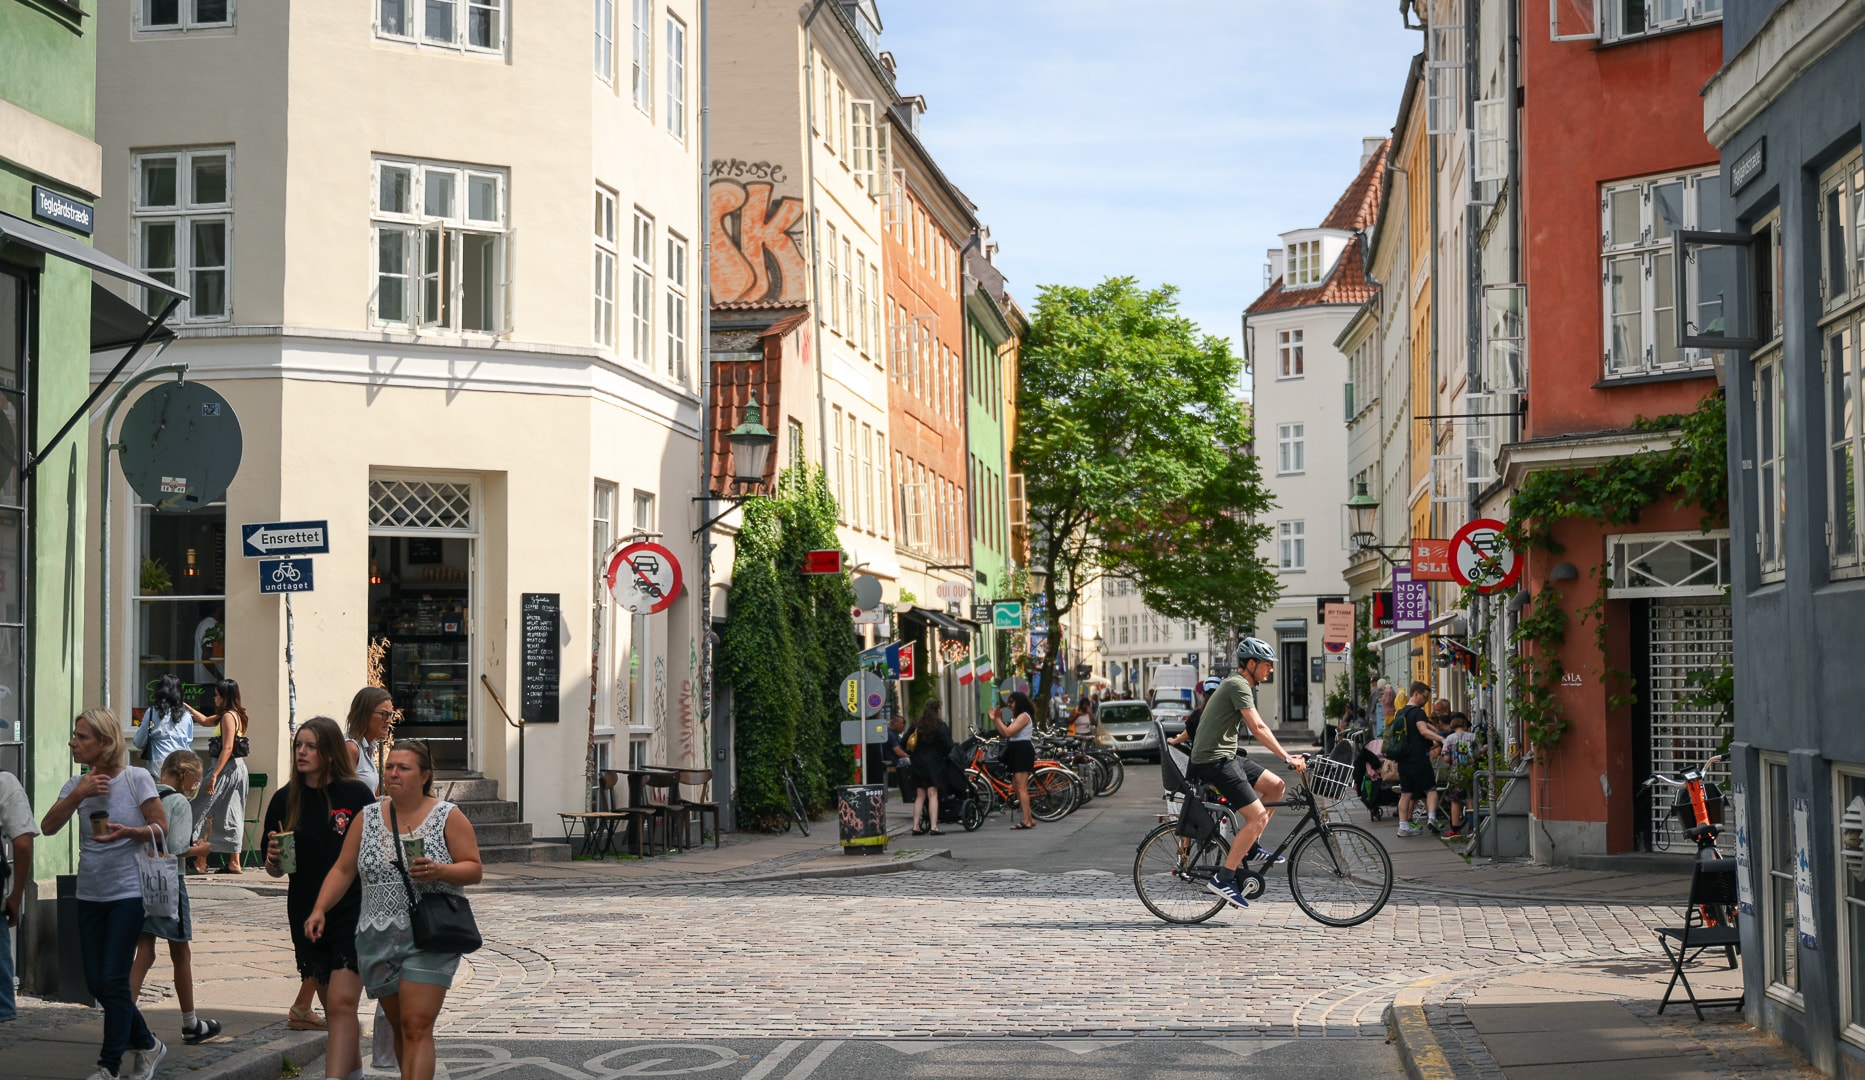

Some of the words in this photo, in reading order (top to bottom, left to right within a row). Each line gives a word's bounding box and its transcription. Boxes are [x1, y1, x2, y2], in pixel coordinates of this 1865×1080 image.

[40, 192, 89, 226] Teglgårdstræde
[261, 531, 319, 544] Ensrettet
[265, 582, 308, 591] undtaget
[937, 585, 950, 597] OUI
[953, 584, 966, 597] OUI
[1190, 654, 1197, 662] P
